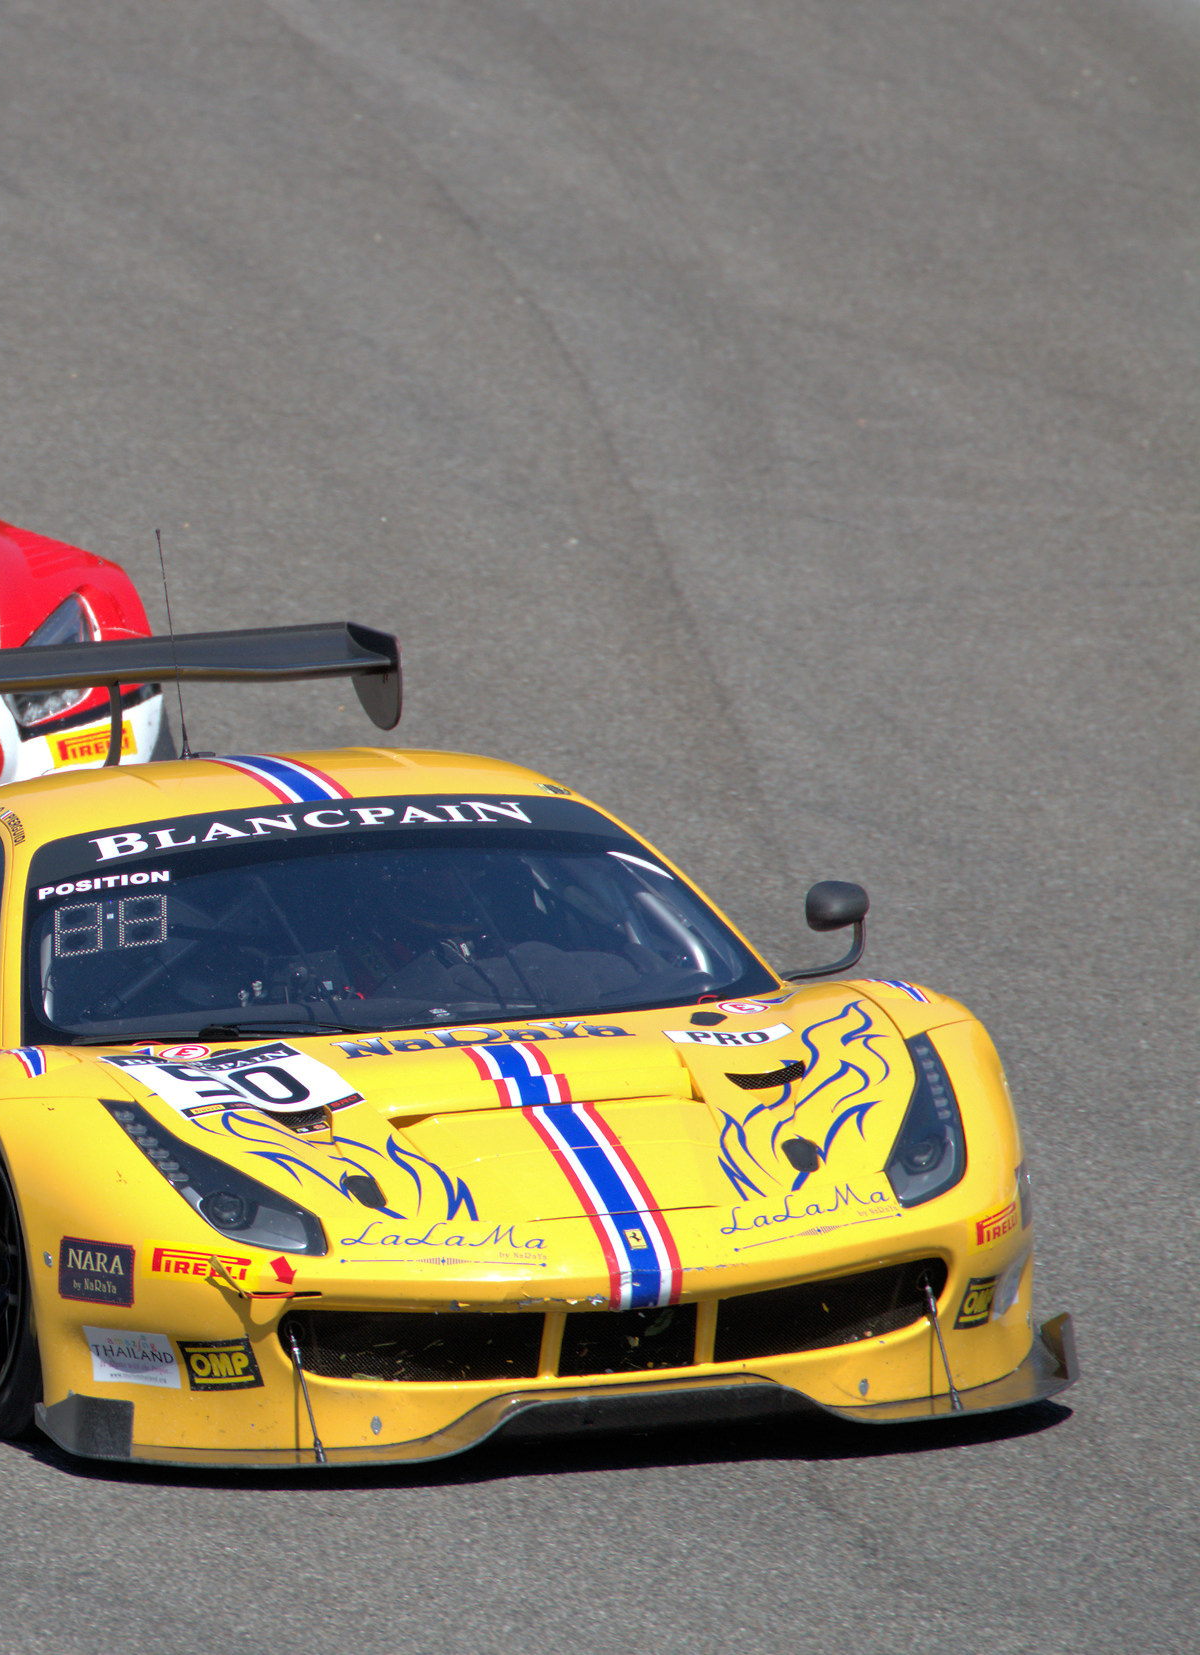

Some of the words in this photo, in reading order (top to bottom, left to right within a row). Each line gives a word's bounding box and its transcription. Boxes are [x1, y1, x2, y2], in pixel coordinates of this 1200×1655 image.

[89, 802, 532, 862] BLANCPAIN
[38, 870, 171, 901] POSITION
[685, 1031, 770, 1045] PRO
[154, 1065, 310, 1104] 50
[976, 1201, 1018, 1246] PIRELLI
[67, 1248, 125, 1276] NARA
[73, 1280, 82, 1291] by
[91, 1344, 175, 1364] THAILAND
[190, 1352, 249, 1377] OMP
